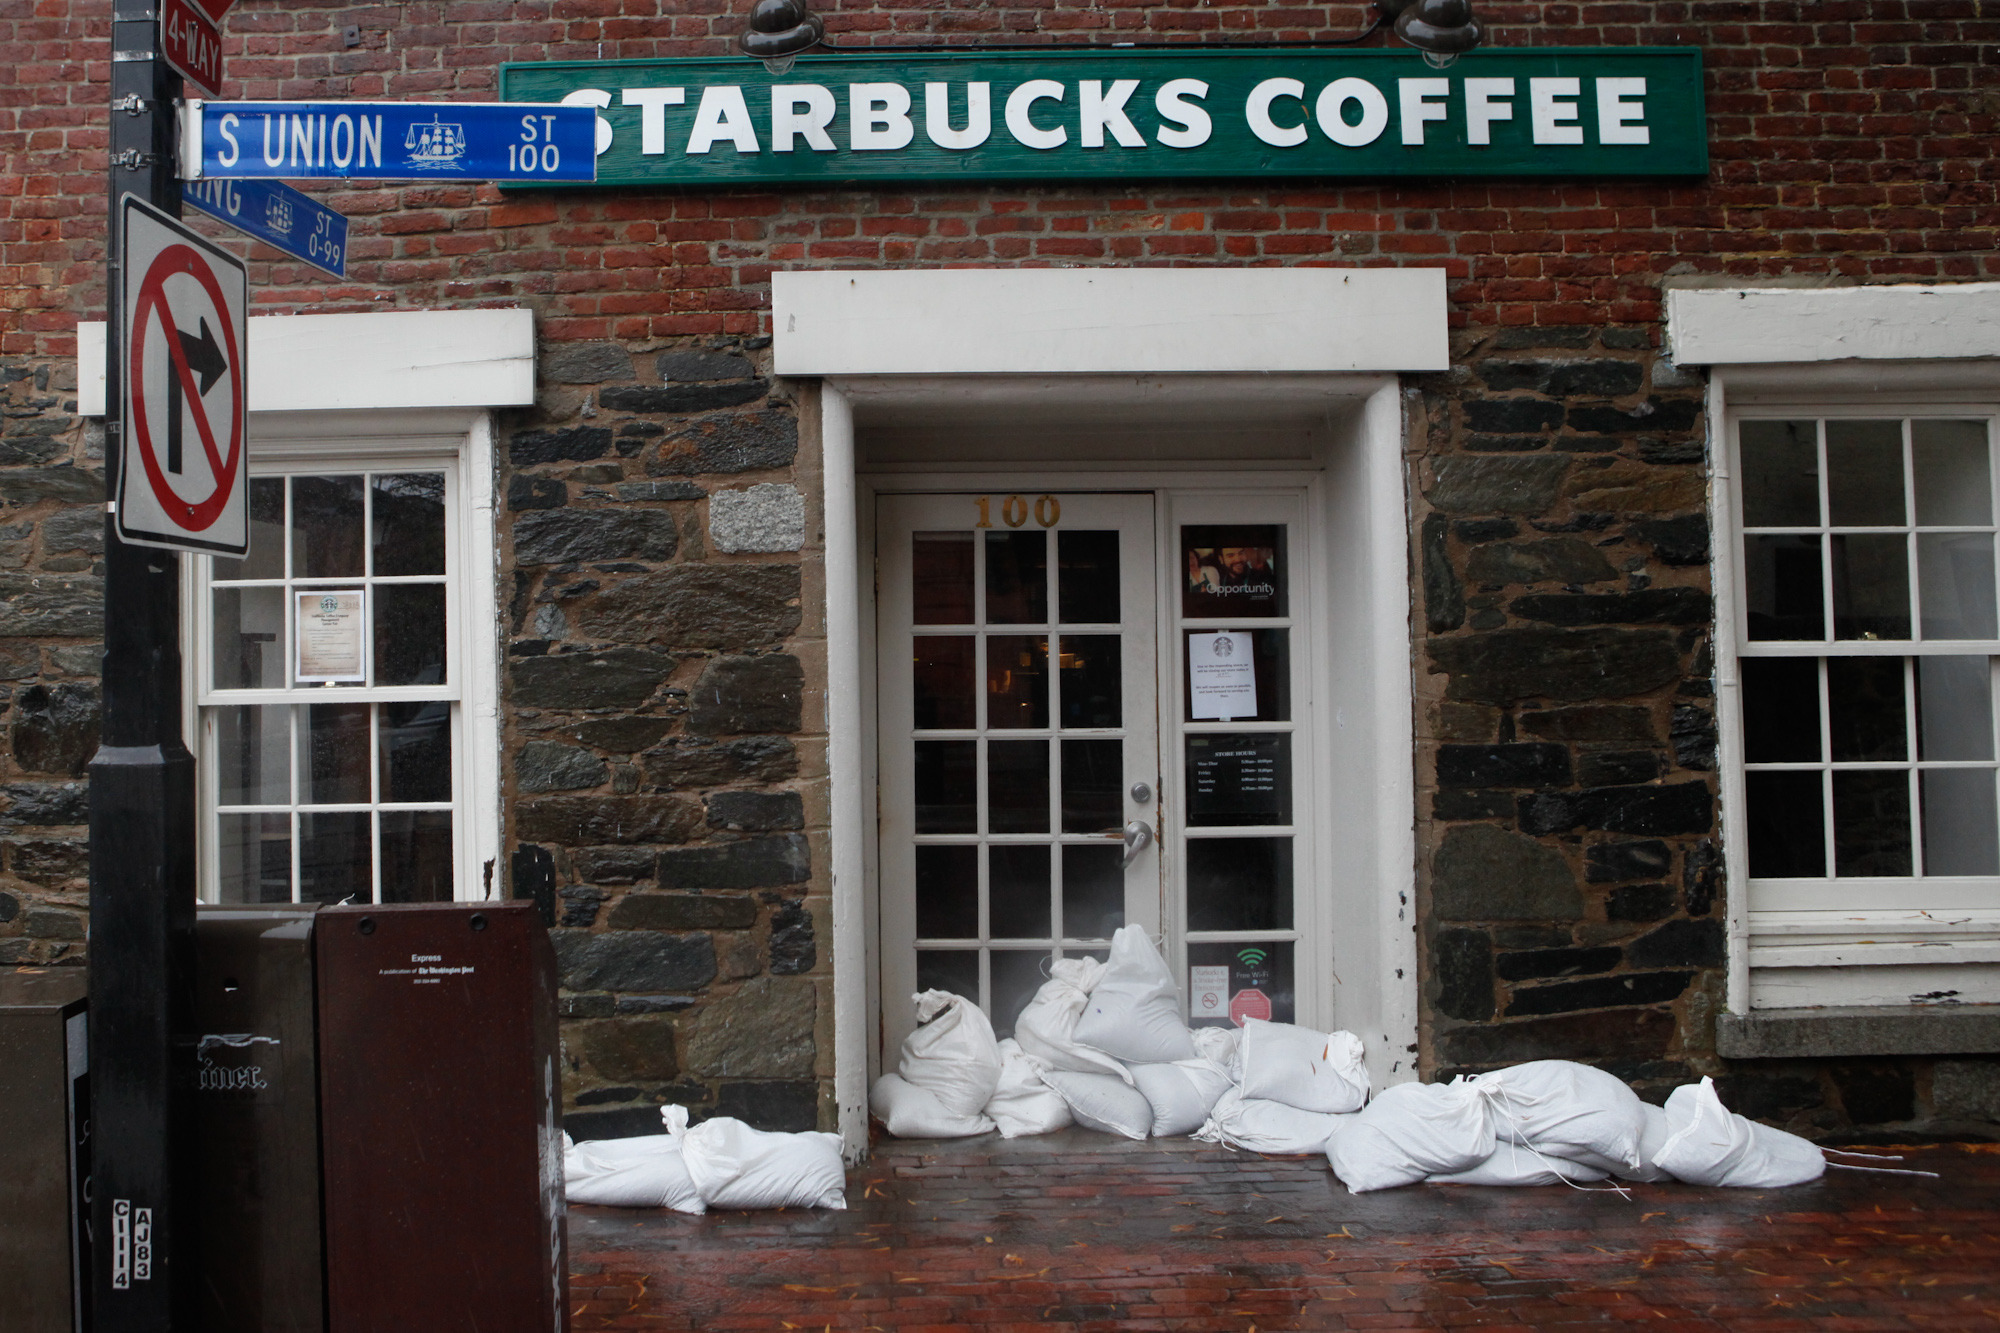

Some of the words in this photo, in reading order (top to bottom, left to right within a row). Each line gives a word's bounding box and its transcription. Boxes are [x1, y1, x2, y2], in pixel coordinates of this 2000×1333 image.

[168, 9, 219, 82] 4-WAY
[1245, 76, 1650, 147] COFFEE
[218, 113, 240, 168] S
[263, 113, 382, 168] UNION
[520, 115, 556, 143] ST
[508, 144, 560, 172] 100
[315, 211, 333, 239] ST
[309, 233, 341, 267] 0-99
[973, 494, 1061, 528] 100
[1206, 582, 1275, 598] Opportunity
[411, 953, 442, 963] Express
[429, 966, 461, 975] Washington
[461, 966, 475, 975] Post
[1251, 970, 1269, 978] Wi-Fi
[136, 1210, 150, 1277] AJ83
